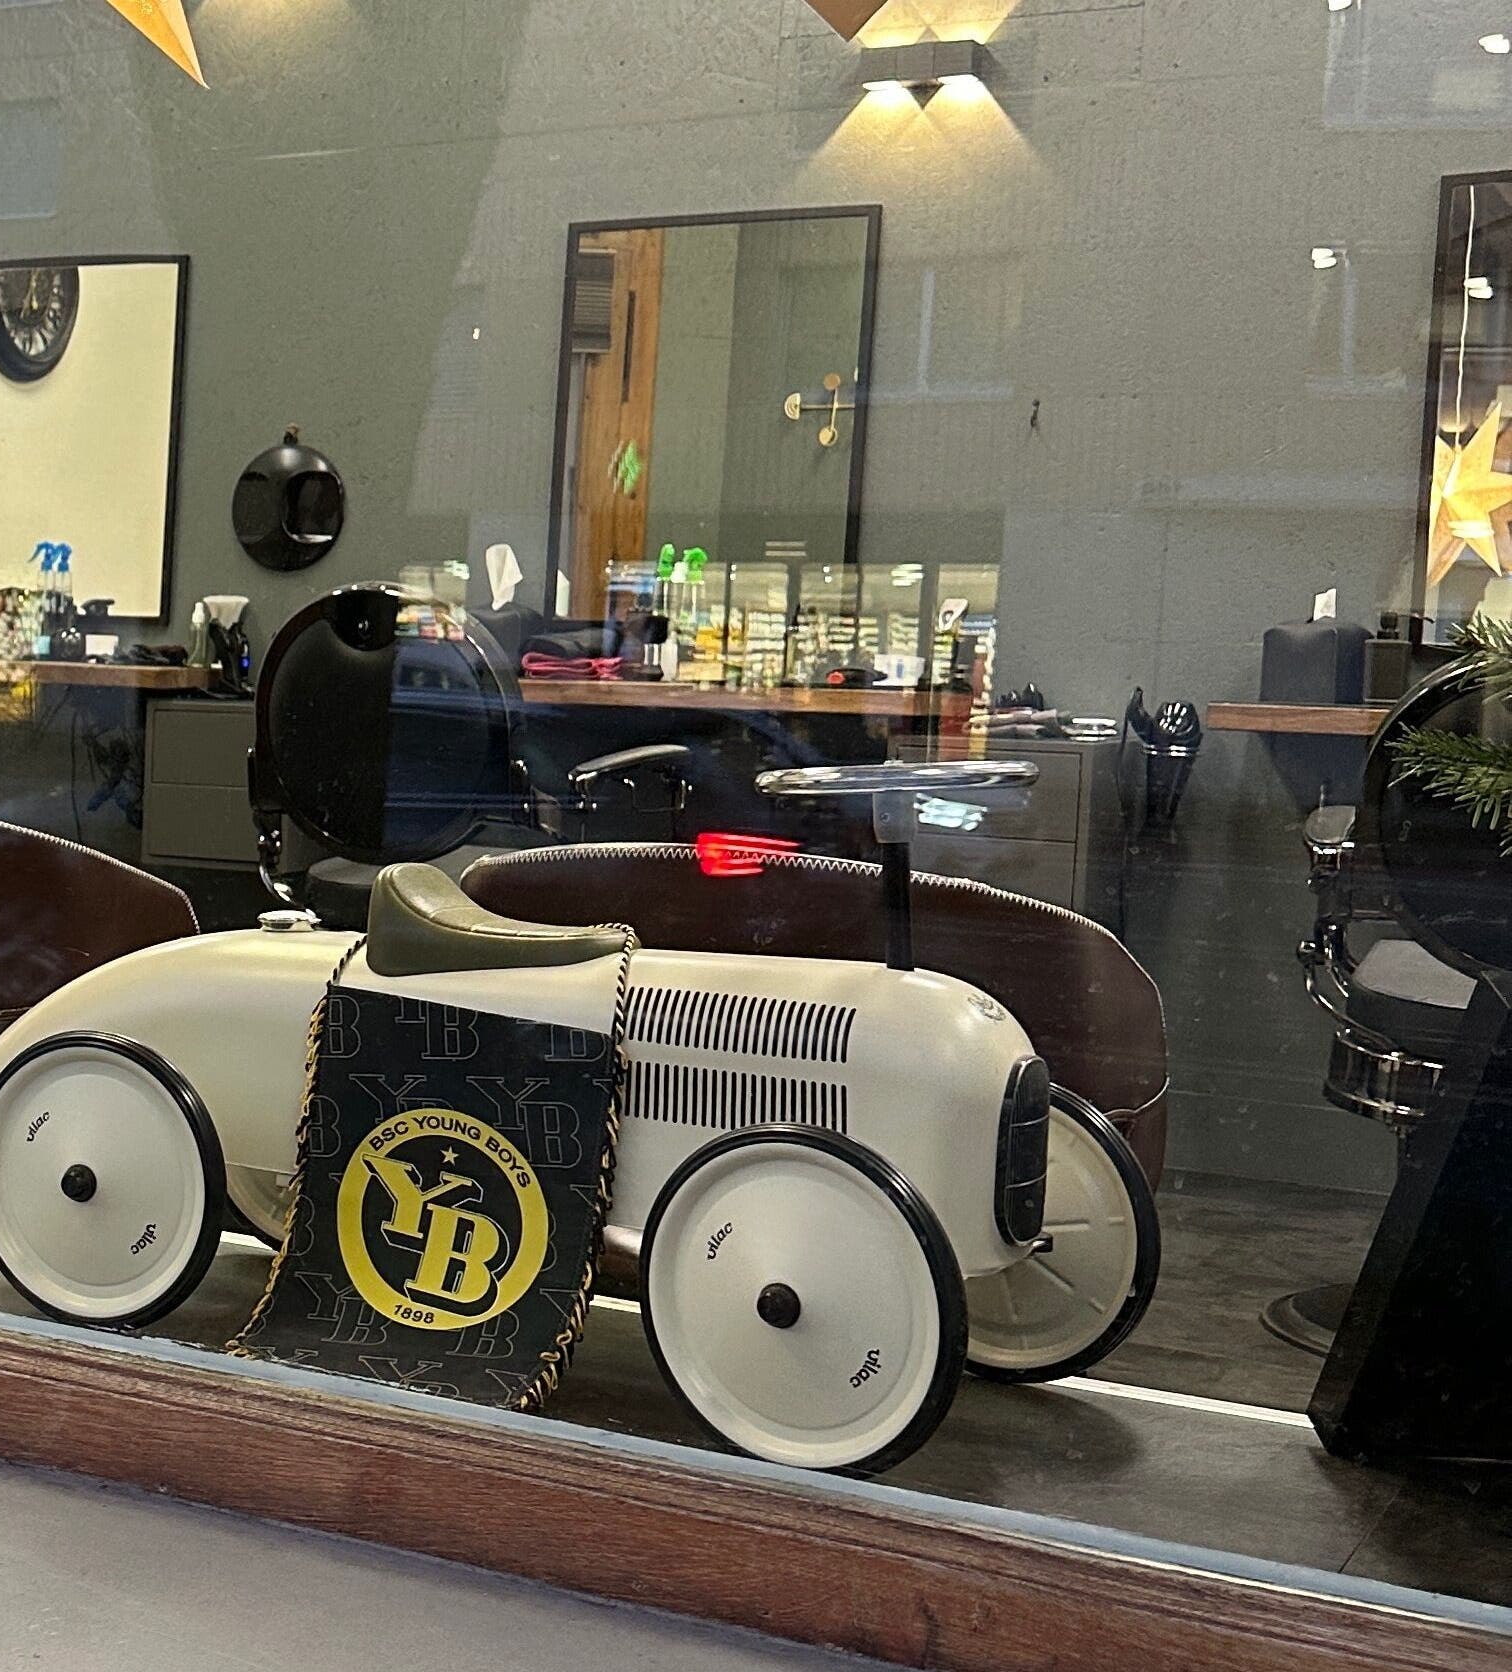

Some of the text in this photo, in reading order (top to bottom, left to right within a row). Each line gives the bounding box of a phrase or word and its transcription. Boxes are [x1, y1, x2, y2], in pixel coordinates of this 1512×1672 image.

[26, 1110, 51, 1143] vilac
[465, 1076, 583, 1169] YB
[368, 1115, 532, 1189] BSC YOUNG BOYS
[130, 1222, 158, 1255] vilac
[362, 1153, 506, 1312] YB
[706, 1221, 733, 1261] vilac
[394, 1303, 435, 1325] 1898
[848, 1348, 882, 1389] vilac
